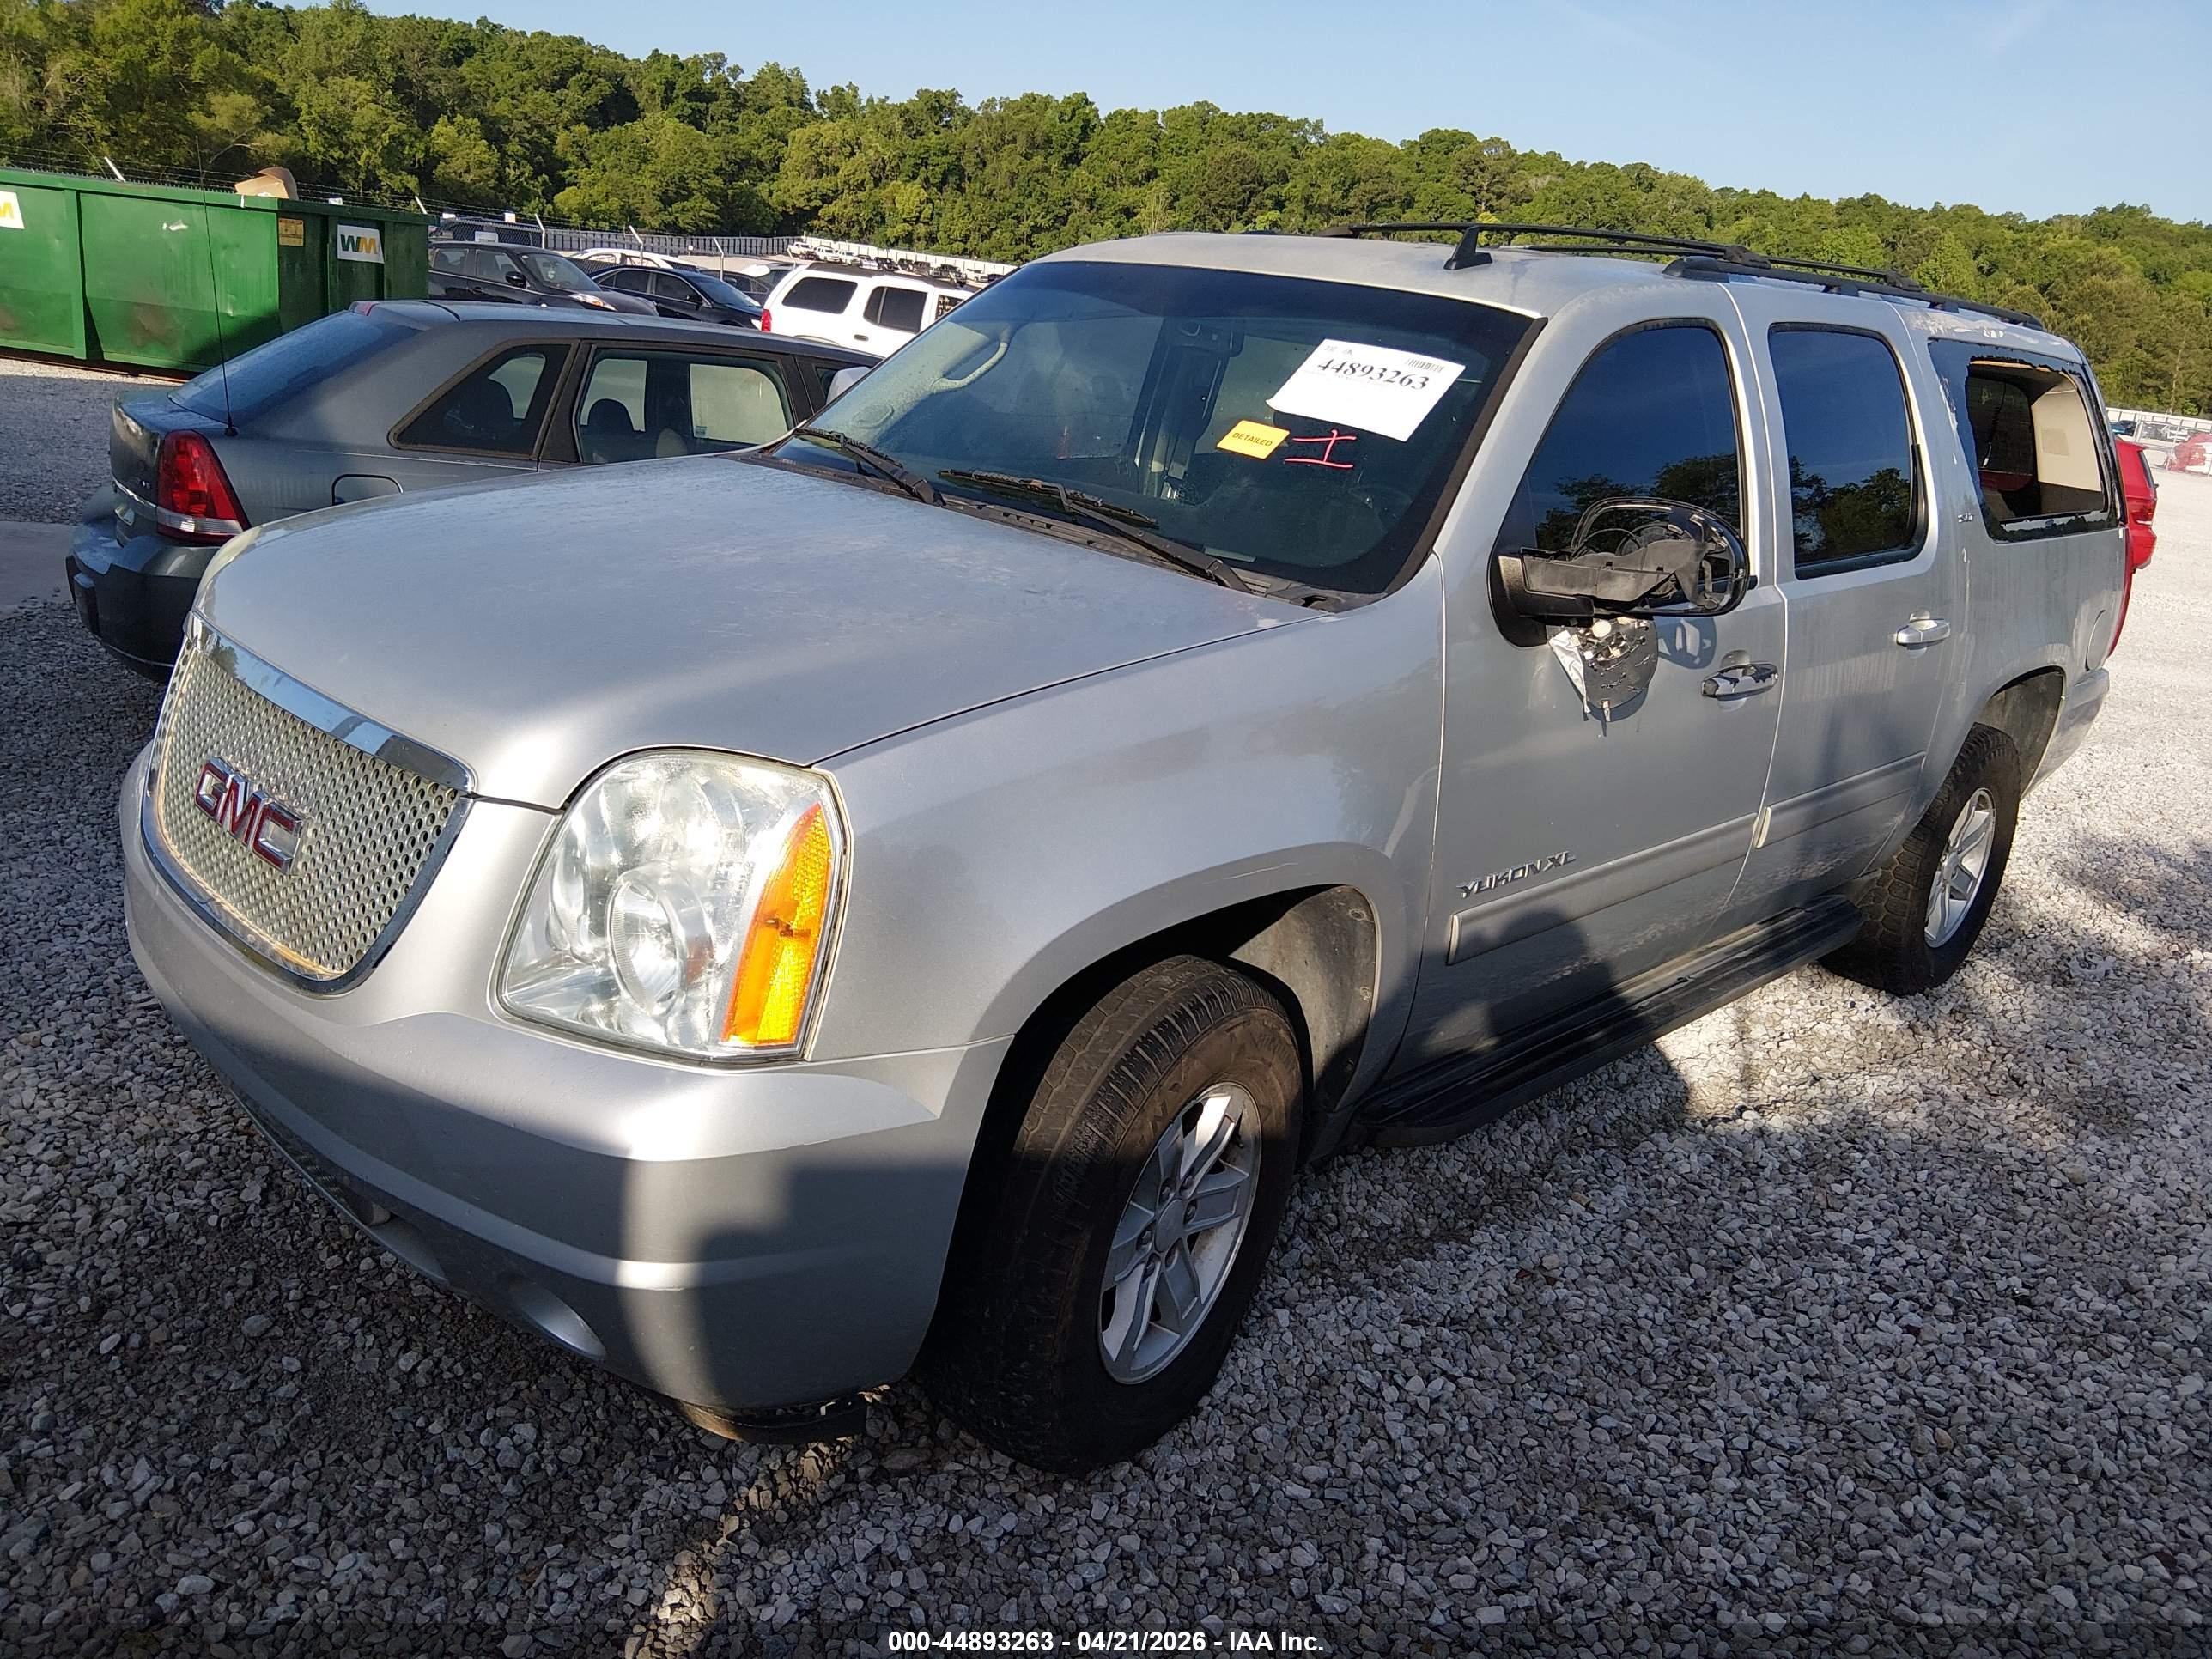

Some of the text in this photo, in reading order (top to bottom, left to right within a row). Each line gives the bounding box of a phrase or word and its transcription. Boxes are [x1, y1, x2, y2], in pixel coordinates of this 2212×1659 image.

[340, 234, 378, 255] WM
[1317, 358, 1430, 390] 44893263
[1231, 432, 1273, 447] DETAILED
[195, 756, 305, 876] GMC
[1457, 850, 1577, 899] YUKON XL
